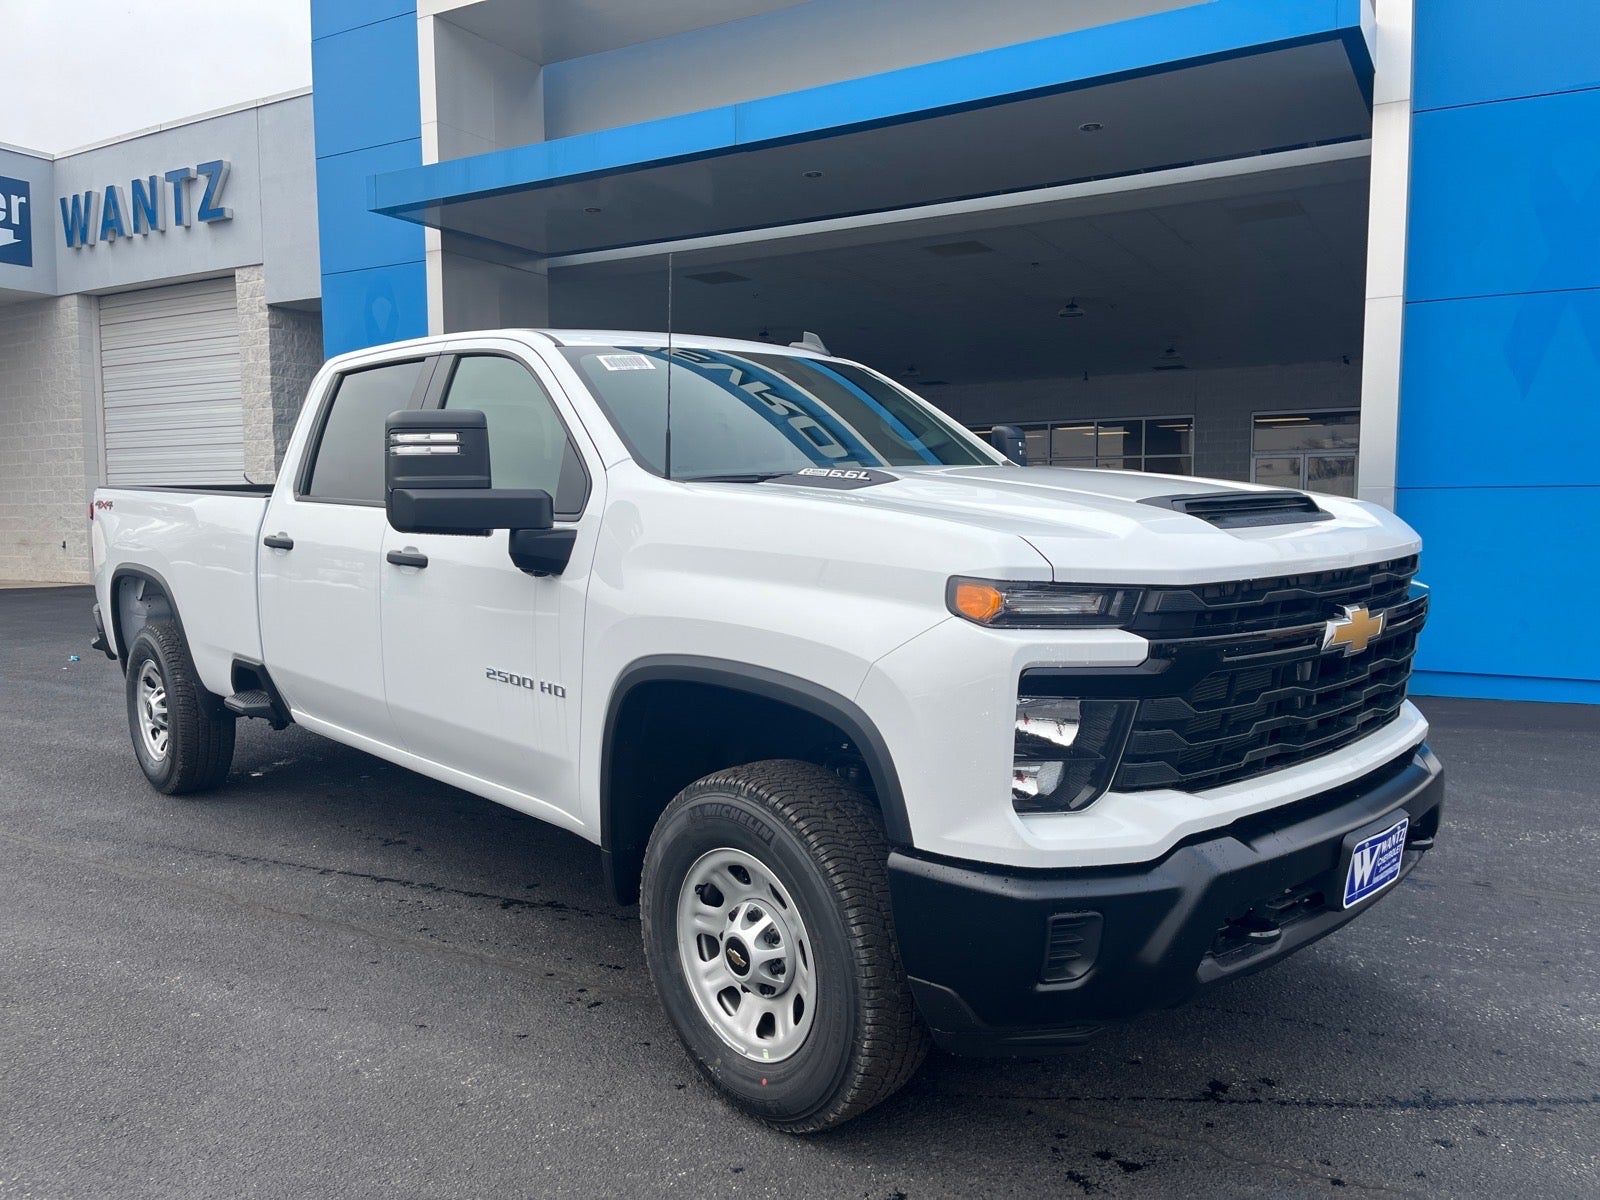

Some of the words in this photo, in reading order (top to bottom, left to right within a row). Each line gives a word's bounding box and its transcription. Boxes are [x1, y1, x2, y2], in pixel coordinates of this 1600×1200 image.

[60, 160, 231, 248] WANTZ
[486, 667, 534, 690] 2500
[540, 681, 567, 698] HD
[704, 804, 775, 842] MICHELIN
[1381, 828, 1406, 854] WANTZ
[1353, 843, 1381, 892] W
